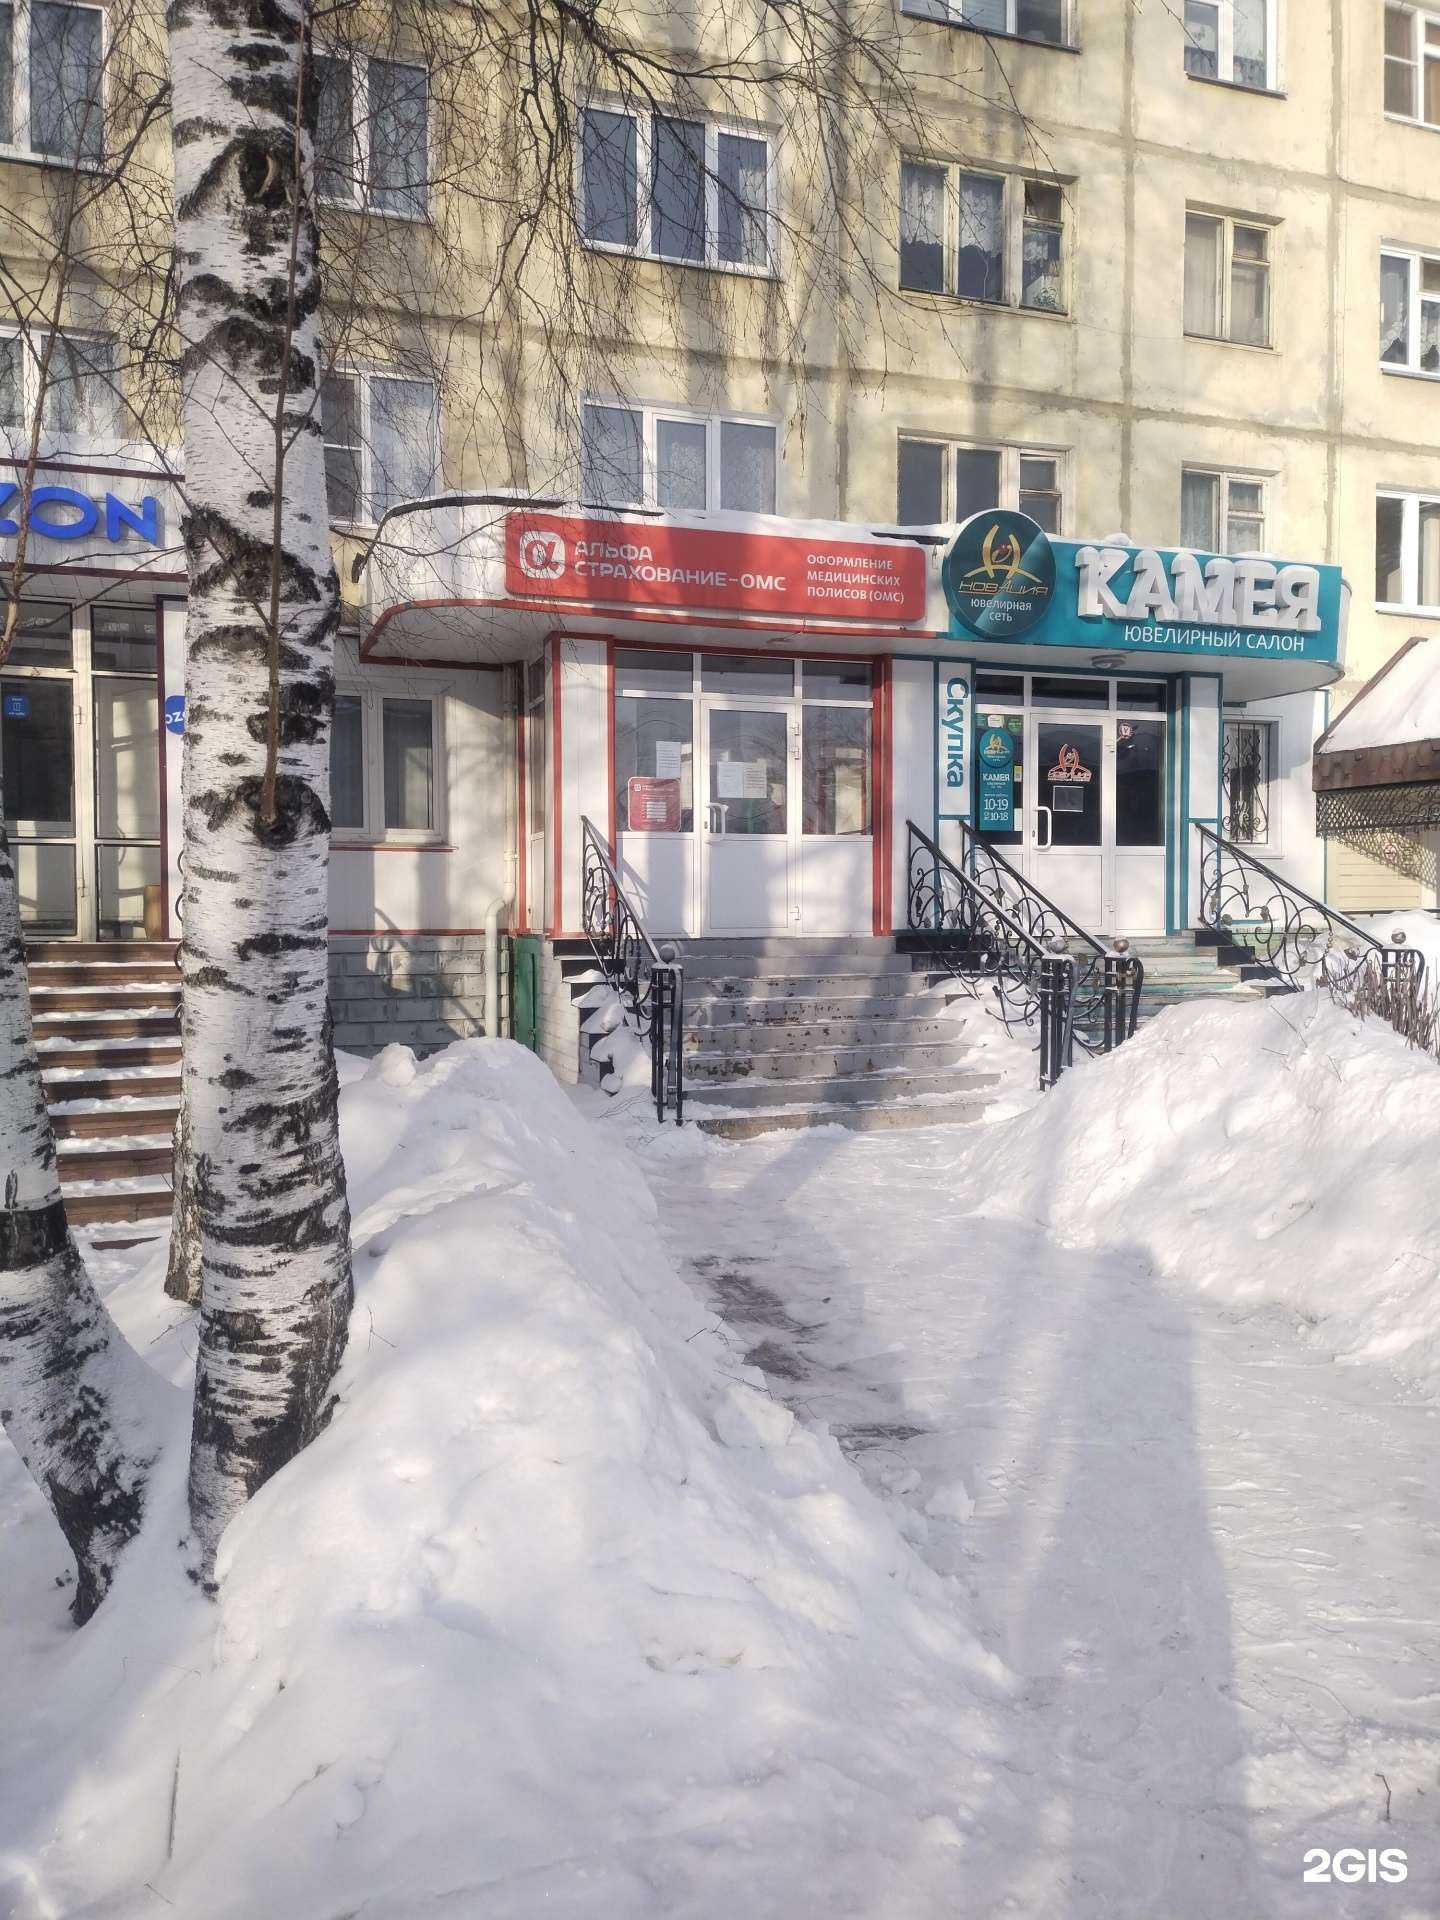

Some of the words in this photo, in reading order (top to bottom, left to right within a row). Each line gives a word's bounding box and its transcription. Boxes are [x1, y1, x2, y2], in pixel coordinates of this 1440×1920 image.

[575, 541, 653, 561] АЛЬФА
[807, 554, 893, 570] ОФОРМЛЕНИЕ
[807, 570, 900, 586] МЕДИЦИНСКИХ
[807, 586, 867, 600] ПОЛИСОВ
[869, 590, 904, 604] (ОМС)
[1075, 546, 1321, 632] КАМЕЯ
[989, 611, 1013, 622] сеть
[1124, 625, 1240, 648] ЮВЕЛИРНЫЙ
[1246, 633, 1305, 652] САЛОН
[941, 677, 969, 787] Скупка
